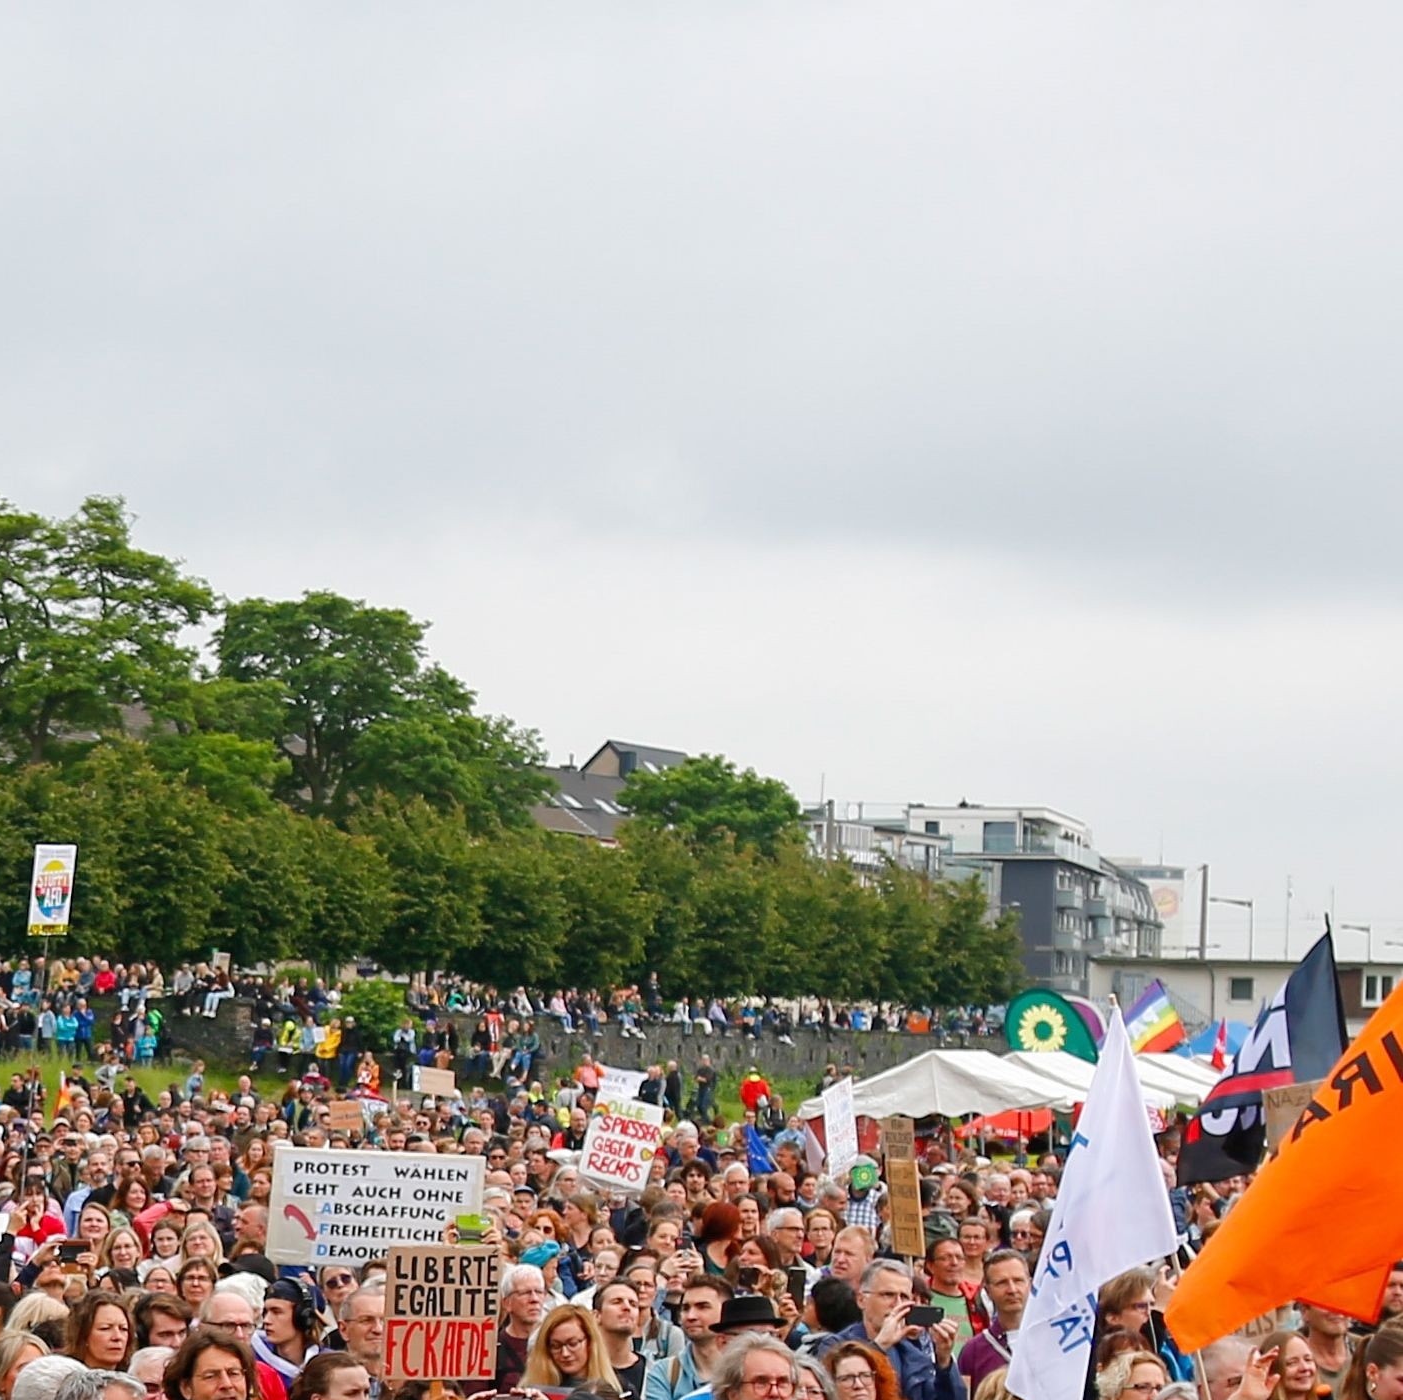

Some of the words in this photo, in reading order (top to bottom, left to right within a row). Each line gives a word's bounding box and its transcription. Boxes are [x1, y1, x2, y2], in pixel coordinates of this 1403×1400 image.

[607, 1100, 646, 1120] OLLE
[592, 1136, 635, 1158] GEGEN
[293, 1161, 370, 1178] PROTEST
[395, 1164, 469, 1183] WÄHLEN
[587, 1152, 643, 1182] RECHTS
[293, 1183, 339, 1196] GEHT
[352, 1186, 401, 1200] AUCH
[413, 1189, 464, 1204] OHNE
[321, 1202, 445, 1221] ABSCHAFFUNG
[395, 1249, 499, 1287] LIBERTÉ
[394, 1284, 498, 1316] EGALITE
